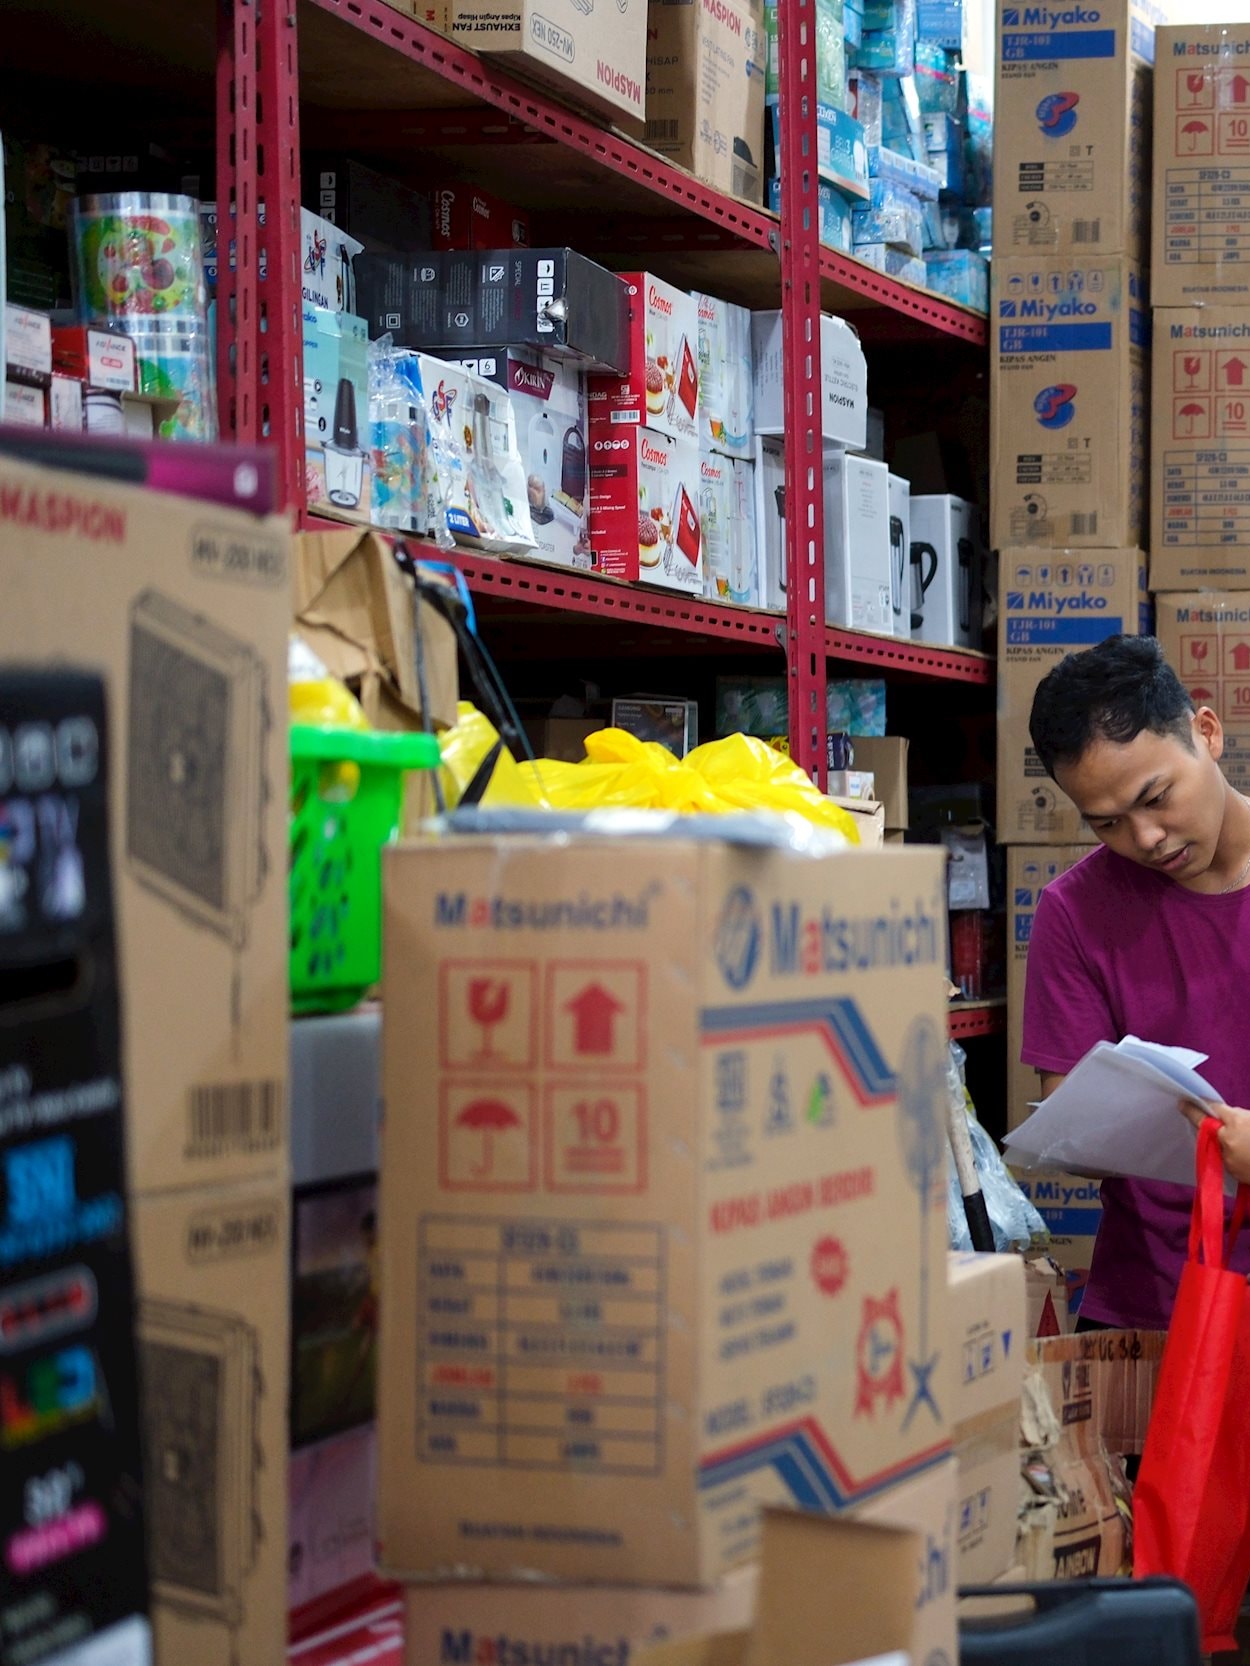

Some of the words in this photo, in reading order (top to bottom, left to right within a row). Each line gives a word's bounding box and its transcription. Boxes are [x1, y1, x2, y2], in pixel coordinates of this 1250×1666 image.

[458, 13, 478, 21] Hisap
[479, 13, 500, 22] Angin
[501, 14, 521, 22] Kipas
[1023, 6, 1100, 28] Miyako
[452, 23, 472, 31] FAN
[474, 23, 521, 32] EXHAUST
[532, 19, 546, 42] NEX
[548, 28, 572, 56] MV-250
[1006, 35, 1051, 46] TJR-101
[1005, 47, 1024, 58] GB
[596, 60, 640, 104] MASPION
[1229, 119, 1247, 137] 10
[441, 190, 455, 238] Cosmos
[649, 285, 672, 316] Cosmos
[1020, 300, 1097, 322] Miyako
[1003, 327, 1048, 338] TJR-101
[1003, 340, 1023, 350] GB
[1000, 355, 1026, 363] KIPAS
[1028, 354, 1056, 362] ANGIN
[523, 374, 545, 390] KIRIN
[829, 393, 855, 409] MASPION
[1226, 402, 1244, 419] 10
[641, 438, 667, 466] Cosmos
[701, 461, 721, 479] Cosmos
[449, 514, 454, 524] 2
[455, 515, 470, 527] LITER
[1028, 592, 1108, 615] Miyako
[1010, 620, 1056, 630] TJR-101
[1010, 632, 1030, 642] GB
[1006, 647, 1034, 655] KIPAS
[1036, 646, 1065, 654] ANGIN
[434, 890, 648, 930] Matsunichi
[770, 897, 937, 976] Matsunichi
[570, 1100, 620, 1142] 10
[1035, 1181, 1099, 1205] Miyak
